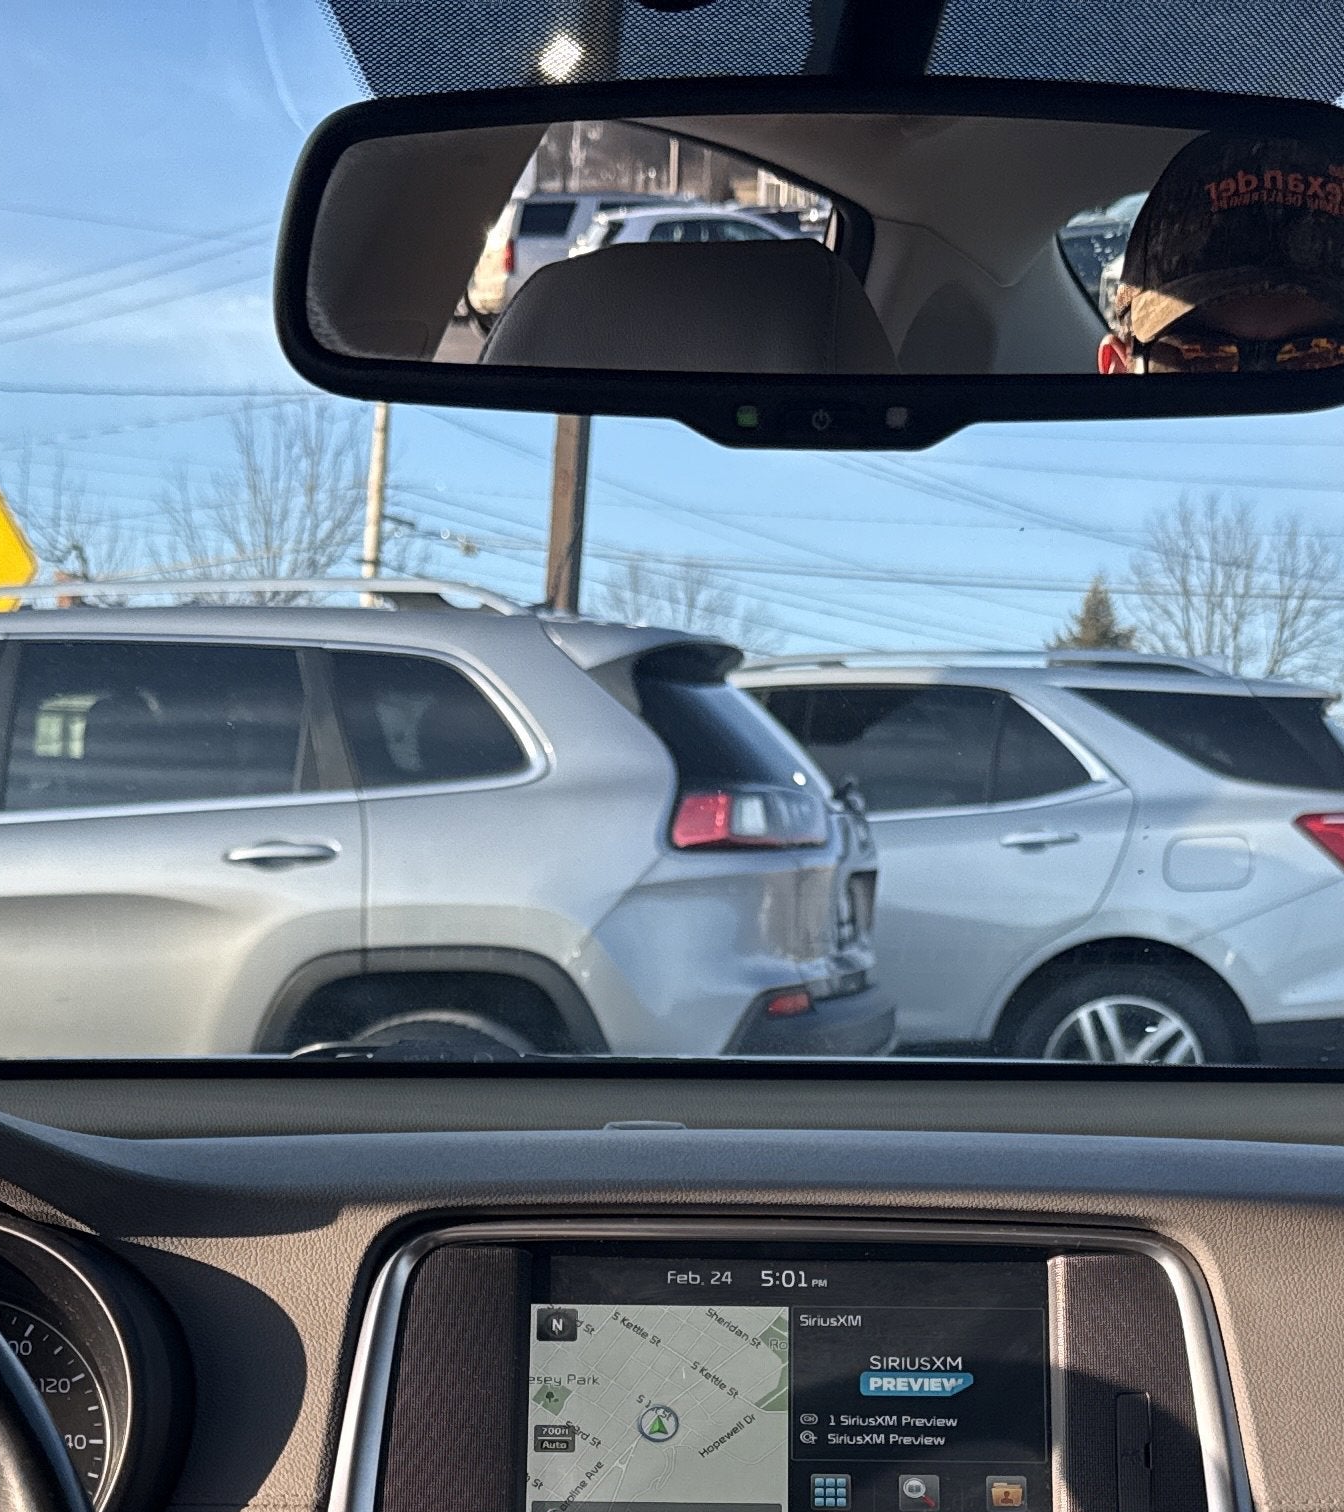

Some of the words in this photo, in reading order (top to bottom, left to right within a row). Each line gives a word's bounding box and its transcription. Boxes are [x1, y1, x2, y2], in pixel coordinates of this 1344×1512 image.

[667, 1270, 705, 1286] Feb.
[710, 1271, 733, 1285] 24
[761, 1270, 808, 1287] 5:01
[811, 1279, 828, 1288] PM
[552, 1319, 563, 1331] N
[799, 1314, 862, 1327] SiriusXM
[612, 1312, 621, 1321] S
[620, 1315, 650, 1340] Kettle
[649, 1335, 662, 1347] St
[705, 1308, 750, 1342] Sheridan
[749, 1337, 762, 1350] St
[869, 1355, 963, 1371] SIRIUSXM
[39, 1378, 71, 1394] 120
[567, 1373, 601, 1386] Park
[690, 1361, 700, 1371] S
[699, 1366, 727, 1391] Kettle
[727, 1387, 740, 1400] St
[869, 1377, 964, 1392] PREVIEW
[828, 1414, 836, 1426] 1
[840, 1415, 898, 1427] SiriusXM
[901, 1415, 958, 1427] Preview
[589, 1436, 602, 1449] St
[698, 1420, 745, 1458] Hopewell
[743, 1413, 756, 1425] Dr
[827, 1433, 885, 1445] SiriusXM
[889, 1433, 946, 1446] Preview
[542, 1440, 567, 1449] Auto
[585, 1461, 604, 1481] Ave
[531, 1478, 544, 1491] St
